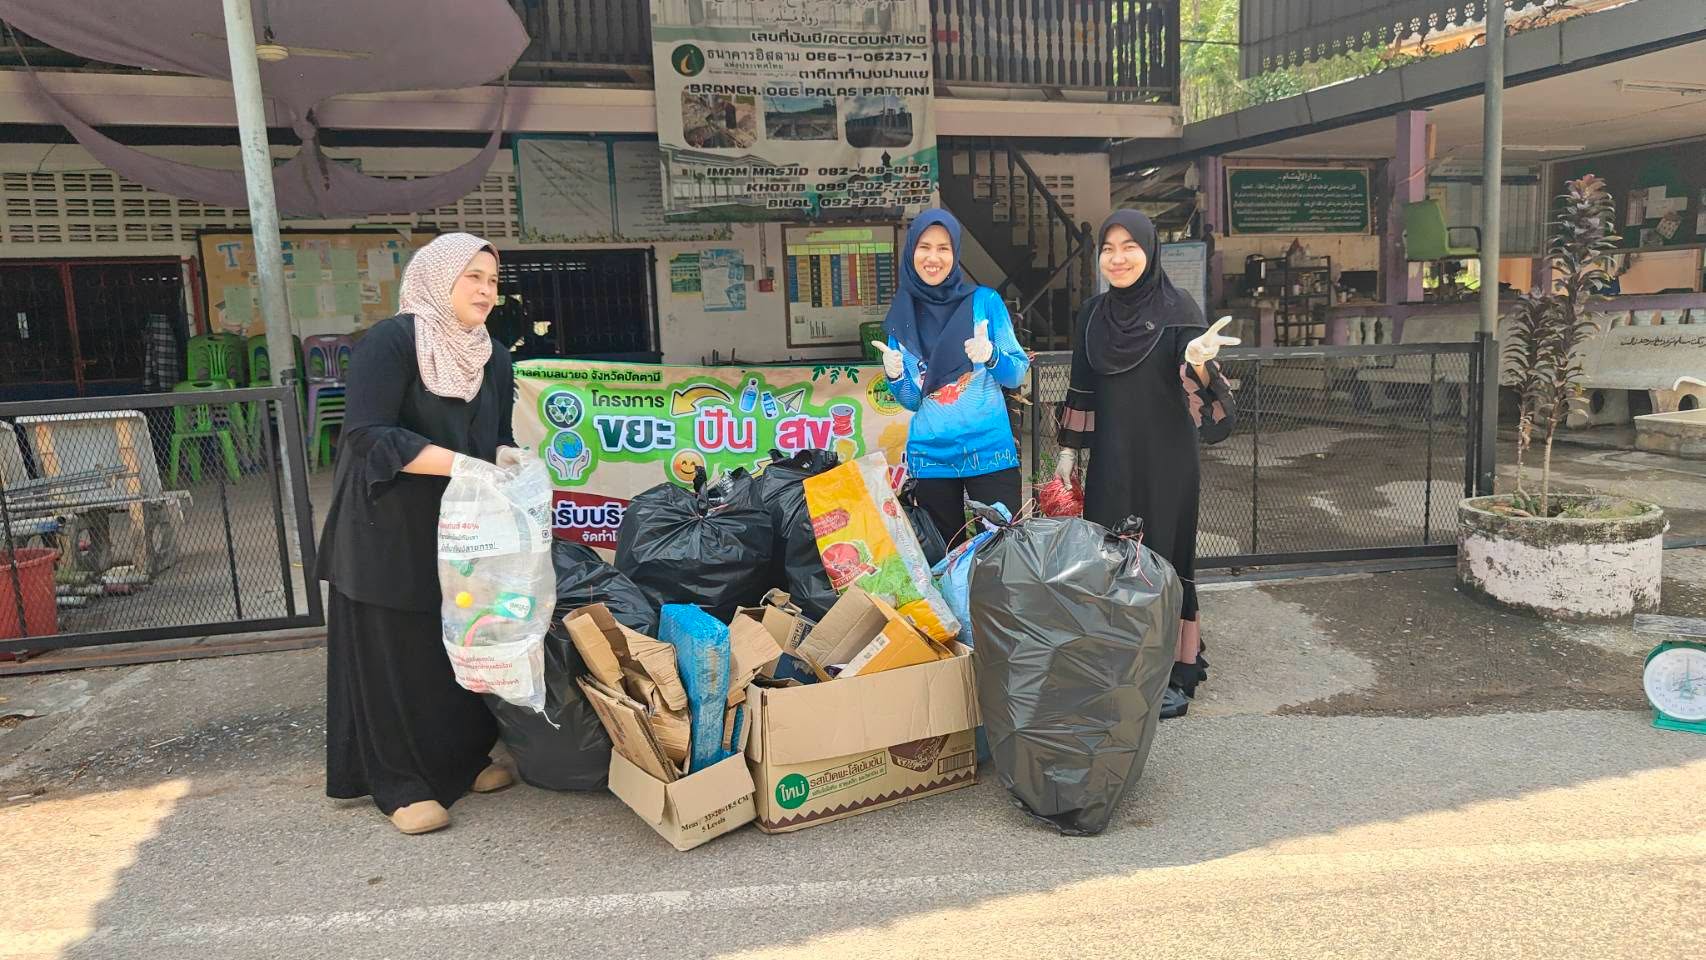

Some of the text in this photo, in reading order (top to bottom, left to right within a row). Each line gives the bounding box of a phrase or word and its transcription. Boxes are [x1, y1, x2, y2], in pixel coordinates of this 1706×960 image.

[906, 35, 926, 45] NO
[805, 87, 858, 97] PALAS
[863, 86, 930, 96] PATTANI
[707, 167, 747, 177] IMAM
[752, 166, 809, 177] MASJID
[747, 183, 806, 193] KHOTIB
[591, 389, 665, 408] โครงการ
[597, 409, 832, 451] ขยะ ปัน สข
[552, 503, 626, 526] รับบริ
[582, 530, 617, 542] จัดทำโ
[779, 781, 805, 802] ใหม่
[737, 794, 749, 805] CM
[707, 817, 726, 830] Levels
